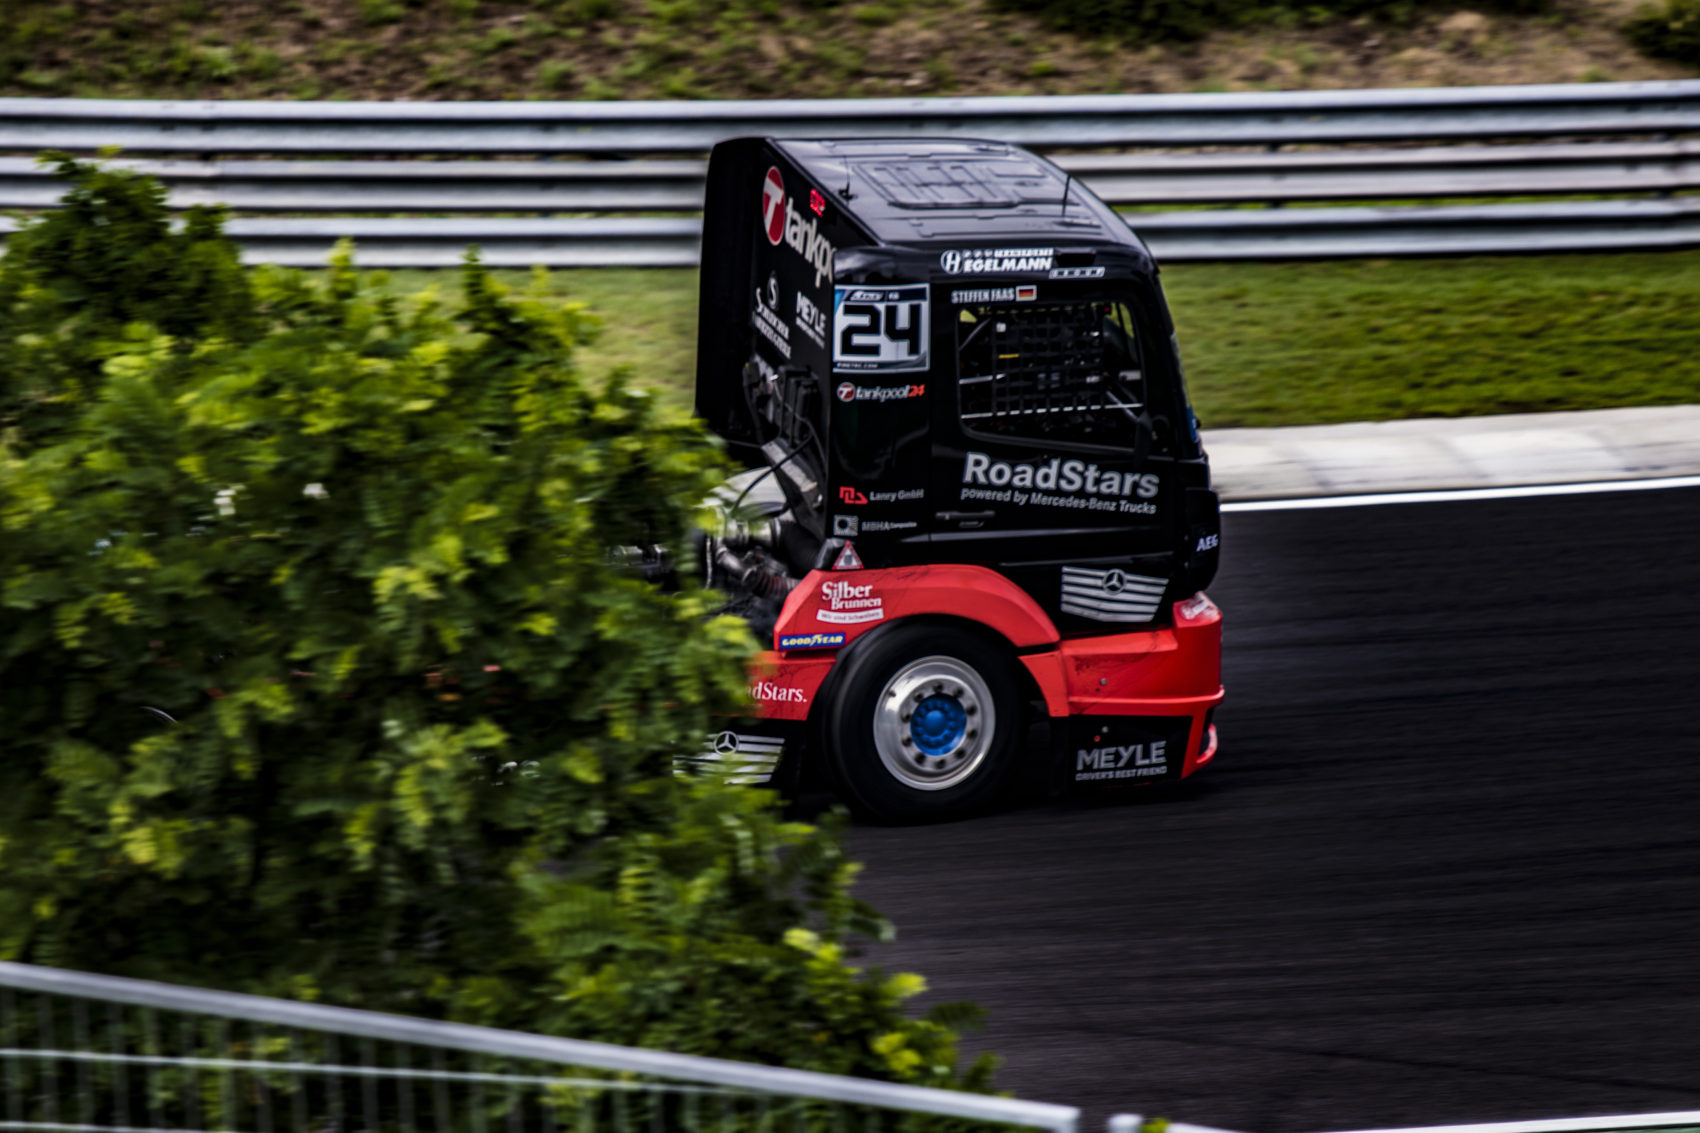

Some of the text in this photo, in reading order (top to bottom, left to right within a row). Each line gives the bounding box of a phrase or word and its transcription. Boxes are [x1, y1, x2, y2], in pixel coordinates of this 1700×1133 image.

[951, 287, 1015, 304] STEFFEN FAAS
[840, 303, 921, 356] 24
[962, 452, 1159, 498] RoadStars
[960, 488, 1156, 514] powered by Mercedes-Benz Trucks
[822, 581, 873, 600] Silber
[831, 598, 882, 610] Brunnen
[782, 634, 843, 646] GOODYEAR
[1076, 740, 1167, 771] MEYLE
[1115, 769, 1136, 779] BEST
[1136, 766, 1167, 777] FRIEND
